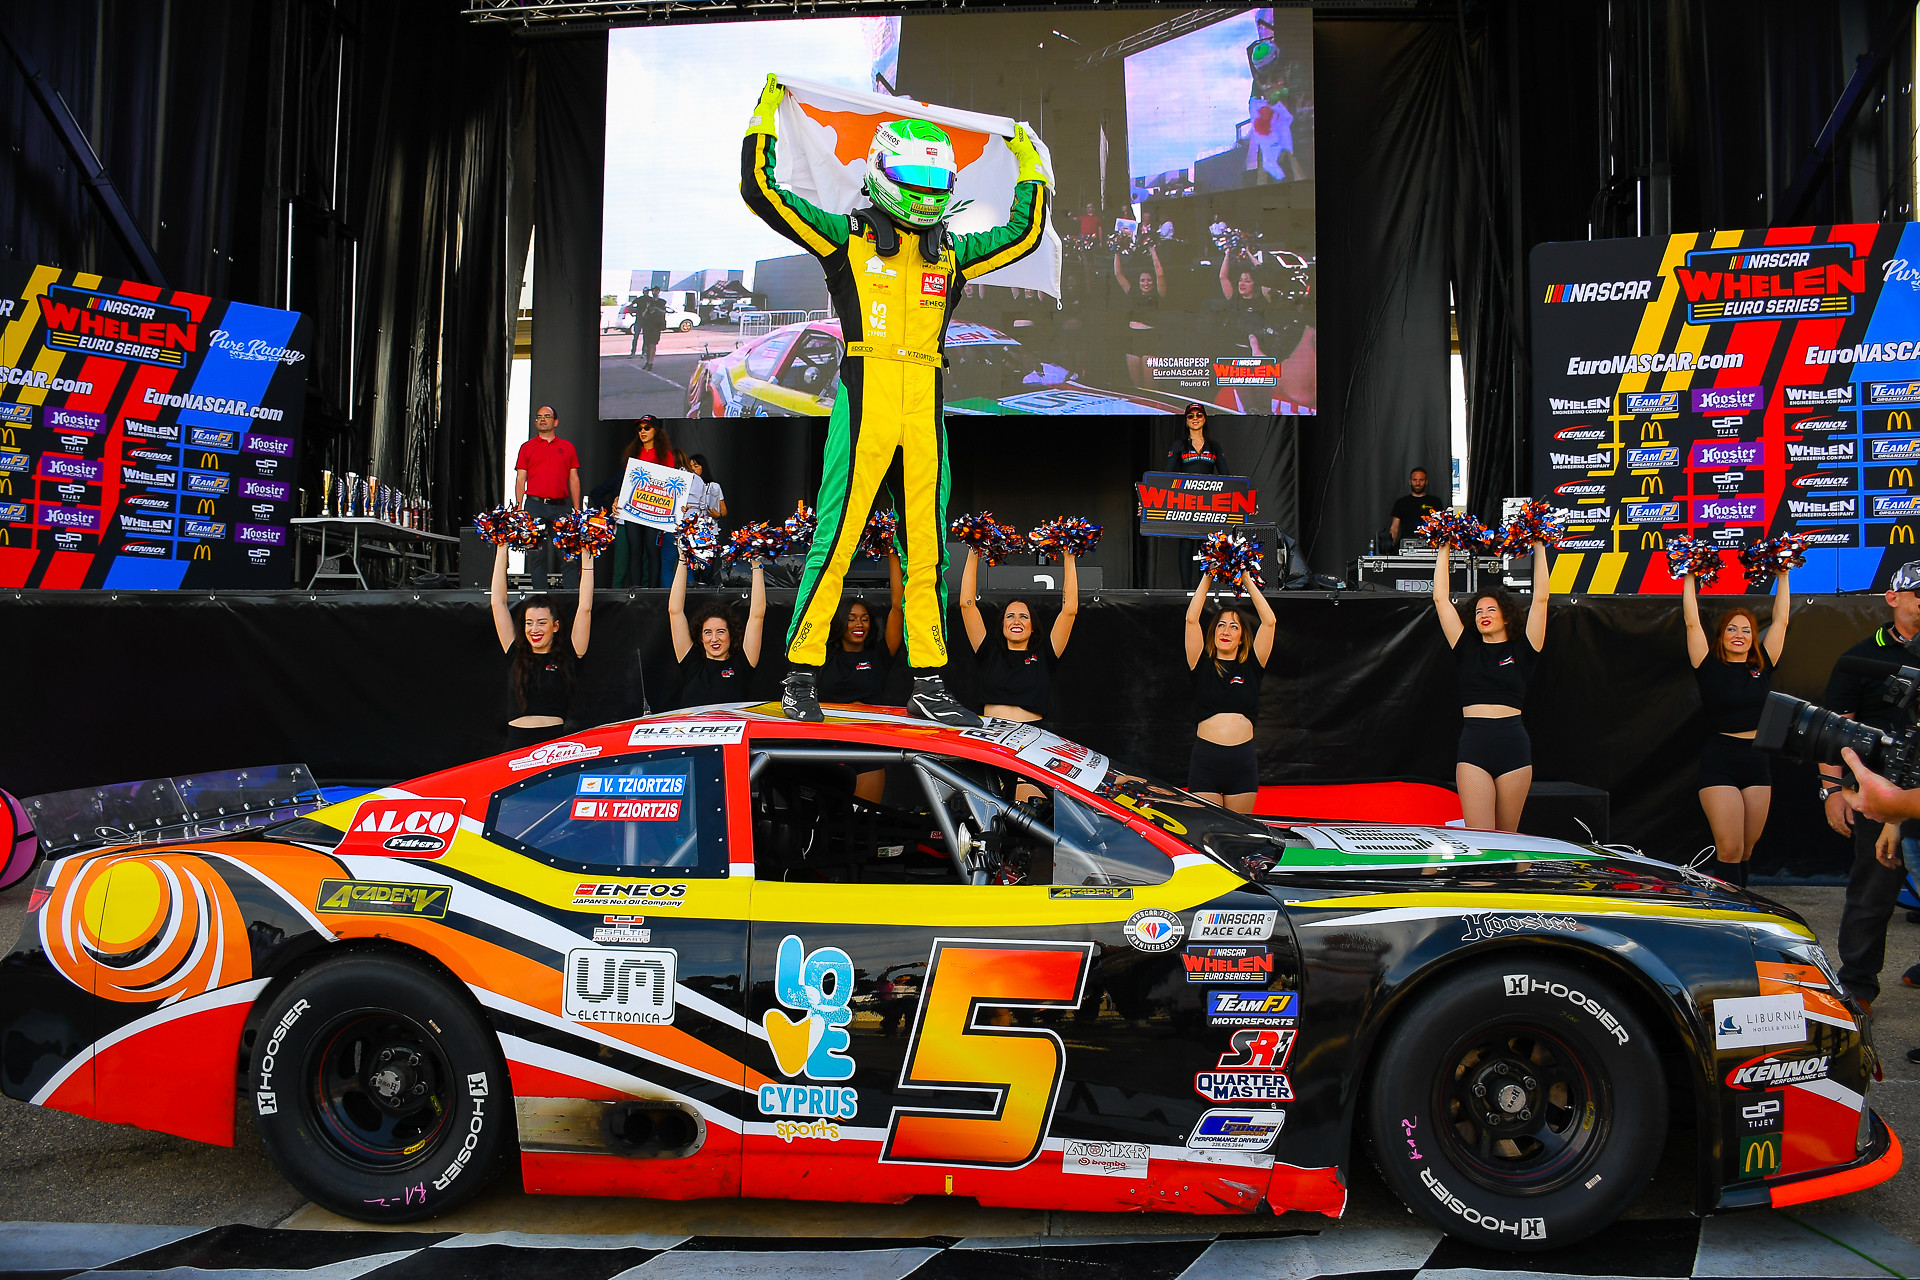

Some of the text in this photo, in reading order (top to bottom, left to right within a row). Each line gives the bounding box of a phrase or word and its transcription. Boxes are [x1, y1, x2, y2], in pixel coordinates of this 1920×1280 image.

[1748, 252, 1809, 269] NASCAR
[924, 276, 945, 284] ALCO
[1676, 258, 1866, 302] WHELEN
[1570, 280, 1651, 303] NASCAR
[103, 299, 156, 320] NASCAR
[1723, 298, 1820, 316] EURO SERIES
[40, 297, 198, 352] WHELEN
[79, 336, 161, 360] EURO SERIES
[209, 329, 244, 351] Pure
[246, 339, 305, 365] Racing
[1147, 358, 1210, 367] #NASCARGPESP
[1567, 352, 1744, 376] EuroNASCAR.com
[1213, 363, 1281, 378] WHELEN
[1699, 390, 1756, 408] Hoosier
[1786, 385, 1853, 400] WHELEN
[143, 387, 284, 422] EuroNASCAR.com
[1549, 396, 1611, 410] WHELEN
[51, 411, 100, 427] Hoosier
[1795, 421, 1848, 430] KENNOL
[125, 419, 179, 437] WHELEN
[1557, 430, 1606, 439] KENNOL
[248, 437, 288, 451] Hoosier
[1786, 442, 1854, 456] WHELEN
[131, 450, 173, 461] KENNOL
[1549, 451, 1611, 464] WHELEN
[1700, 446, 1756, 463] Hoosier
[48, 460, 98, 476] Hoosier
[123, 466, 176, 484] WHELEN
[244, 482, 285, 496] Hoosier
[1184, 479, 1223, 491] NASCAR
[1557, 485, 1606, 493] KENNOL
[1796, 477, 1849, 486] KENNOL
[128, 497, 170, 507] KENNOL
[636, 492, 671, 507] VALENCIA
[1138, 484, 1257, 513] WHELEN
[1787, 499, 1855, 513] WHELEN
[45, 509, 95, 524] Hoosier
[1165, 510, 1227, 523] EURO SERIES
[1700, 502, 1757, 519] Hoosier
[120, 514, 172, 530] WHELEN
[240, 527, 281, 540] Hoosier
[124, 544, 166, 554] KENNOL
[1557, 539, 1606, 548] KENNOL
[603, 778, 683, 793] V. TZIORTZIS
[598, 802, 678, 817] V. TZIORTZIS
[353, 811, 455, 834] ALCO
[595, 884, 687, 897] ENEOS
[1053, 889, 1129, 897] ACADEMY
[322, 885, 445, 912] ACADEMY
[641, 899, 682, 907] Company
[1132, 910, 1177, 924] NASCAR 75TH
[1218, 914, 1265, 925] NASCAR
[595, 928, 650, 936] PSALTIS
[1201, 927, 1262, 936] RACE CAR
[1461, 911, 1578, 941] Hoosier
[1130, 935, 1179, 951] ANNIVERSARY
[1216, 949, 1247, 957] NASCAR
[1181, 954, 1273, 972] WHELEN
[578, 1010, 660, 1023] ELETTRONICA
[1531, 979, 1629, 1046] HOOSIER
[1746, 1010, 1804, 1024] LIBURNIA
[1211, 1018, 1294, 1026] MOTORSPORTS
[260, 998, 311, 1089] HOOSIER
[878, 937, 1095, 1171] 5
[1733, 1056, 1828, 1085] KENNOL
[1197, 1073, 1285, 1091] QUARTER
[1770, 1073, 1817, 1085] PERFORMANCE
[1213, 1085, 1290, 1099] MASTER
[760, 1086, 857, 1116] CYPRUS
[1748, 1118, 1774, 1128] TIJEY
[777, 1121, 839, 1141] sports
[433, 1099, 485, 1191] HOOSIER
[1092, 1159, 1126, 1167] brembo
[1420, 1167, 1518, 1235] HOOSIER
